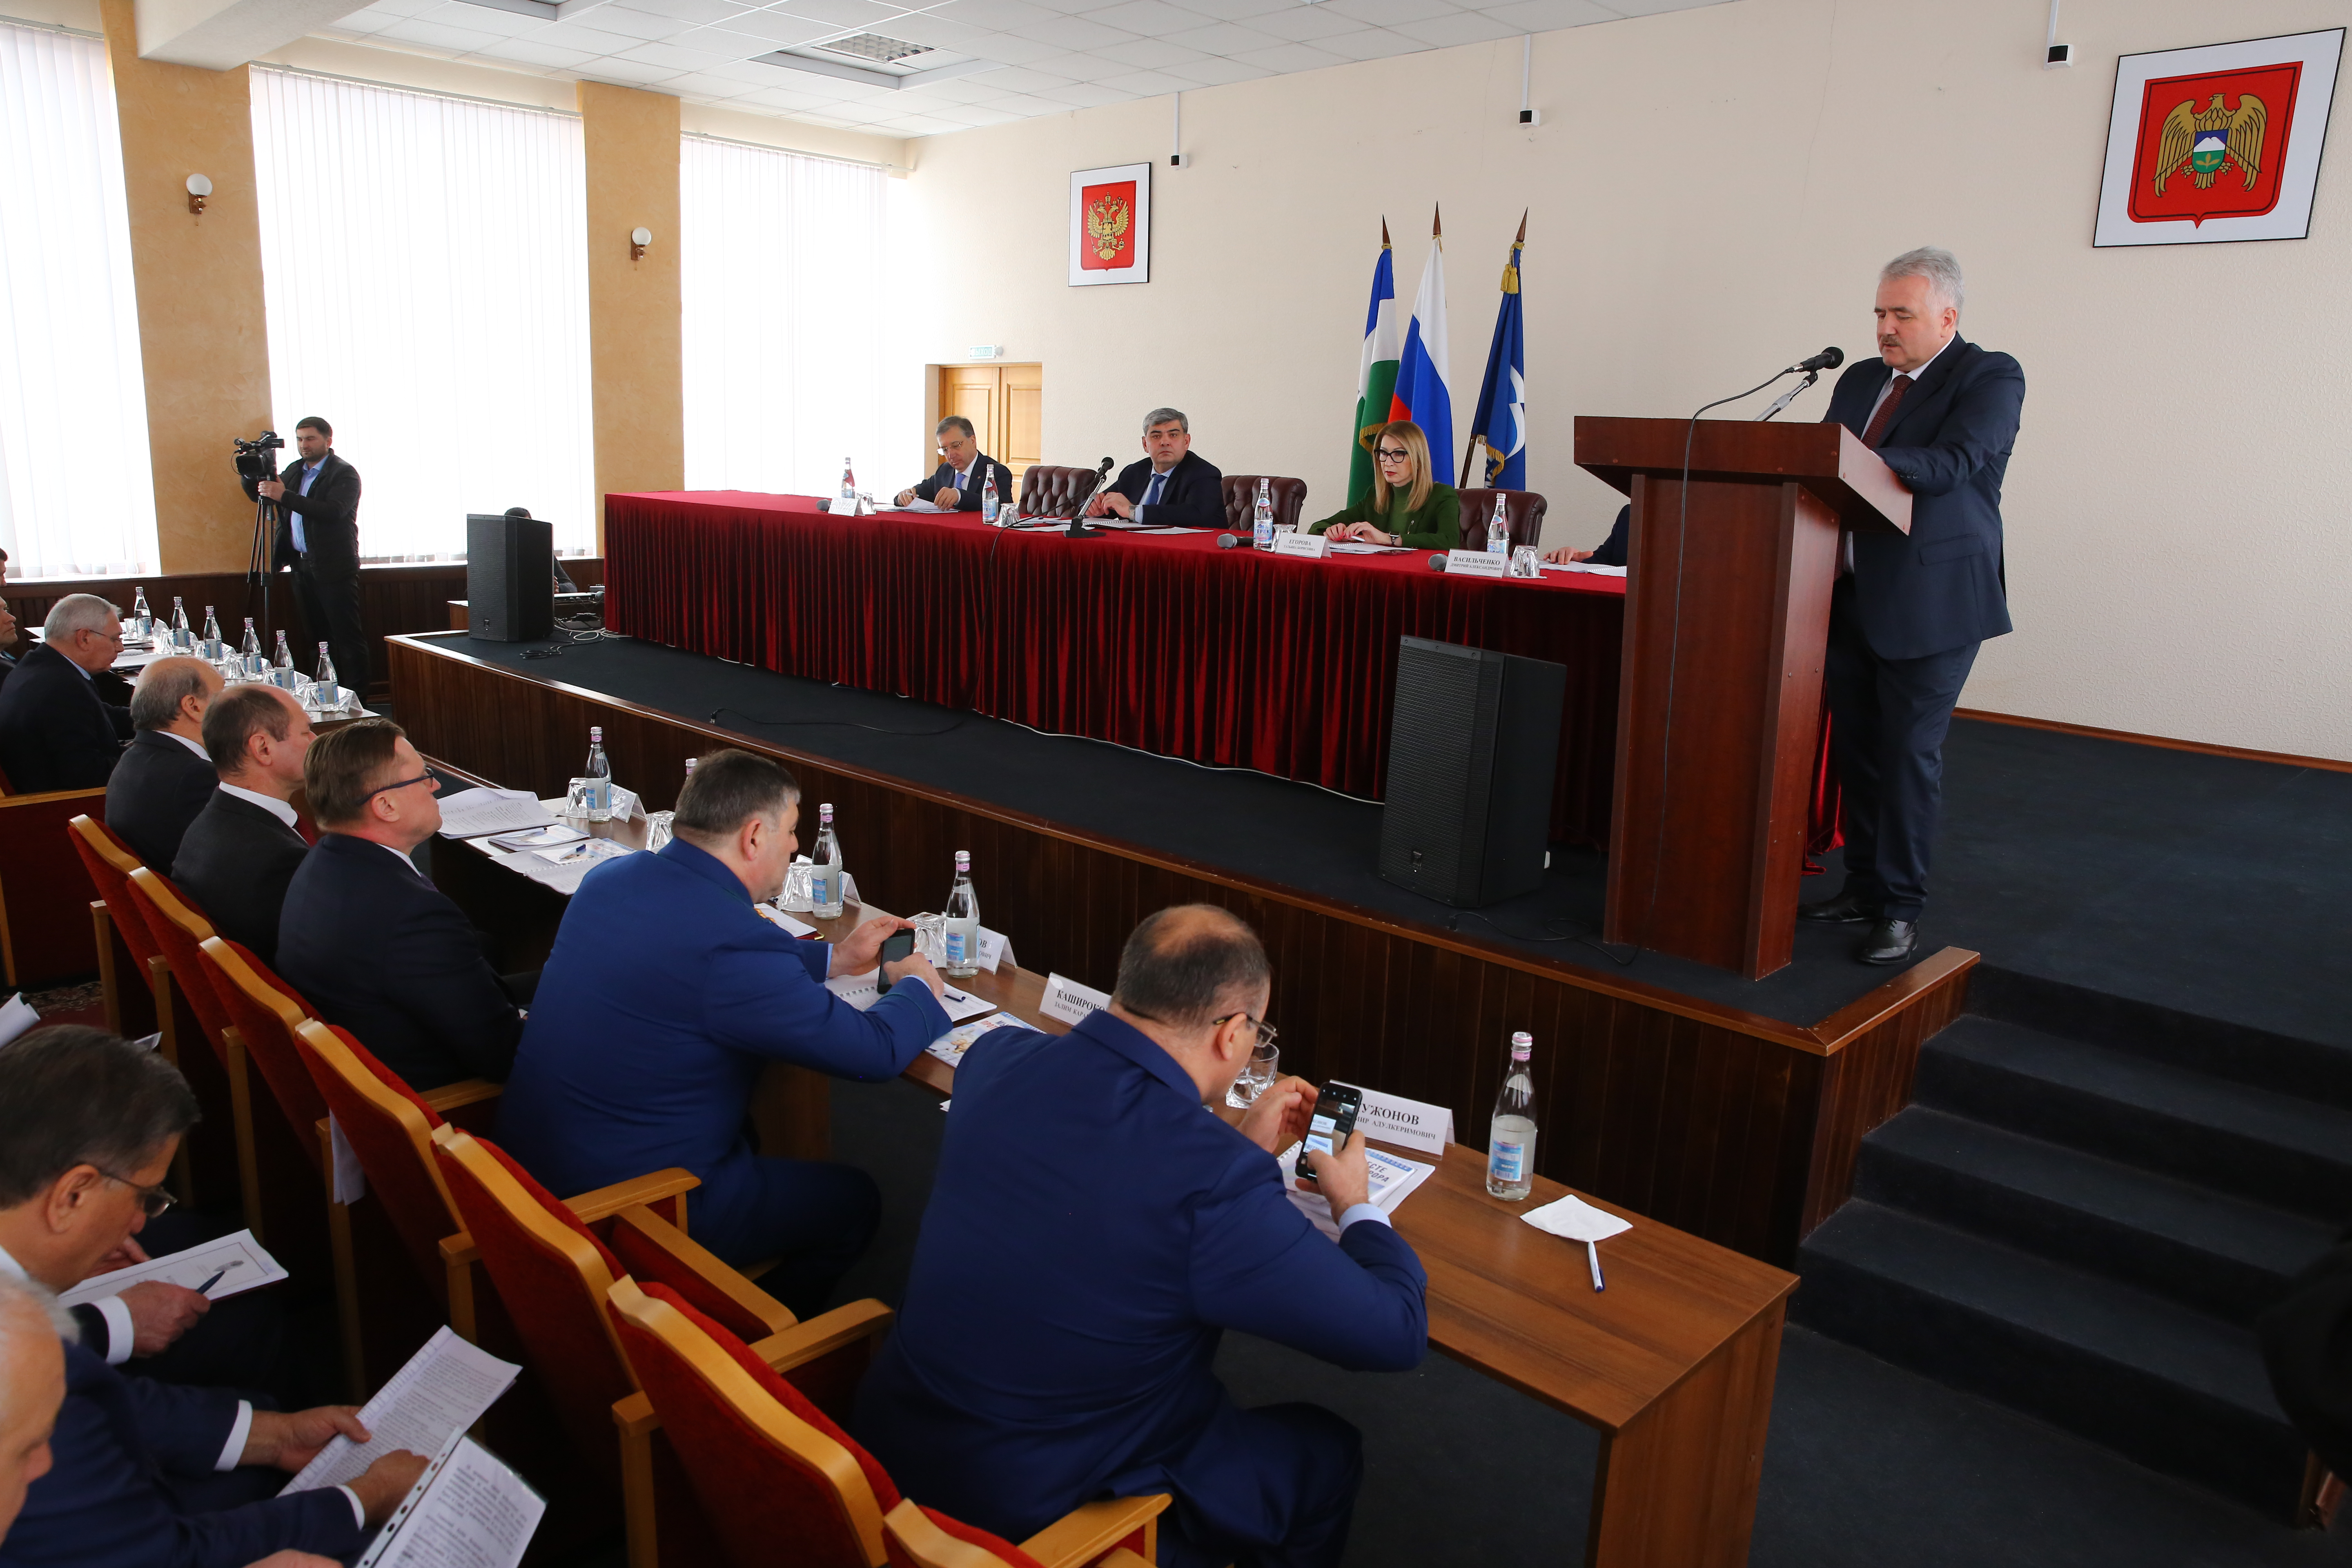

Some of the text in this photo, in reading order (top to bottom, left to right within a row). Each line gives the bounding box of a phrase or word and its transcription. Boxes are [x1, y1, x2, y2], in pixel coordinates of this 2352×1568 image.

[971, 348, 992, 356] ВЫХОД
[1454, 557, 1500, 566] ВАСИЛЬЧЕНКО
[1054, 1001, 1072, 1012] ЗАЛИМ
[1057, 990, 1107, 1011] КАШИРОКО
[1359, 1103, 1419, 1125] УЖОНОВ
[1372, 1120, 1436, 1139] АДУЛКЕРИМОВИЧ
